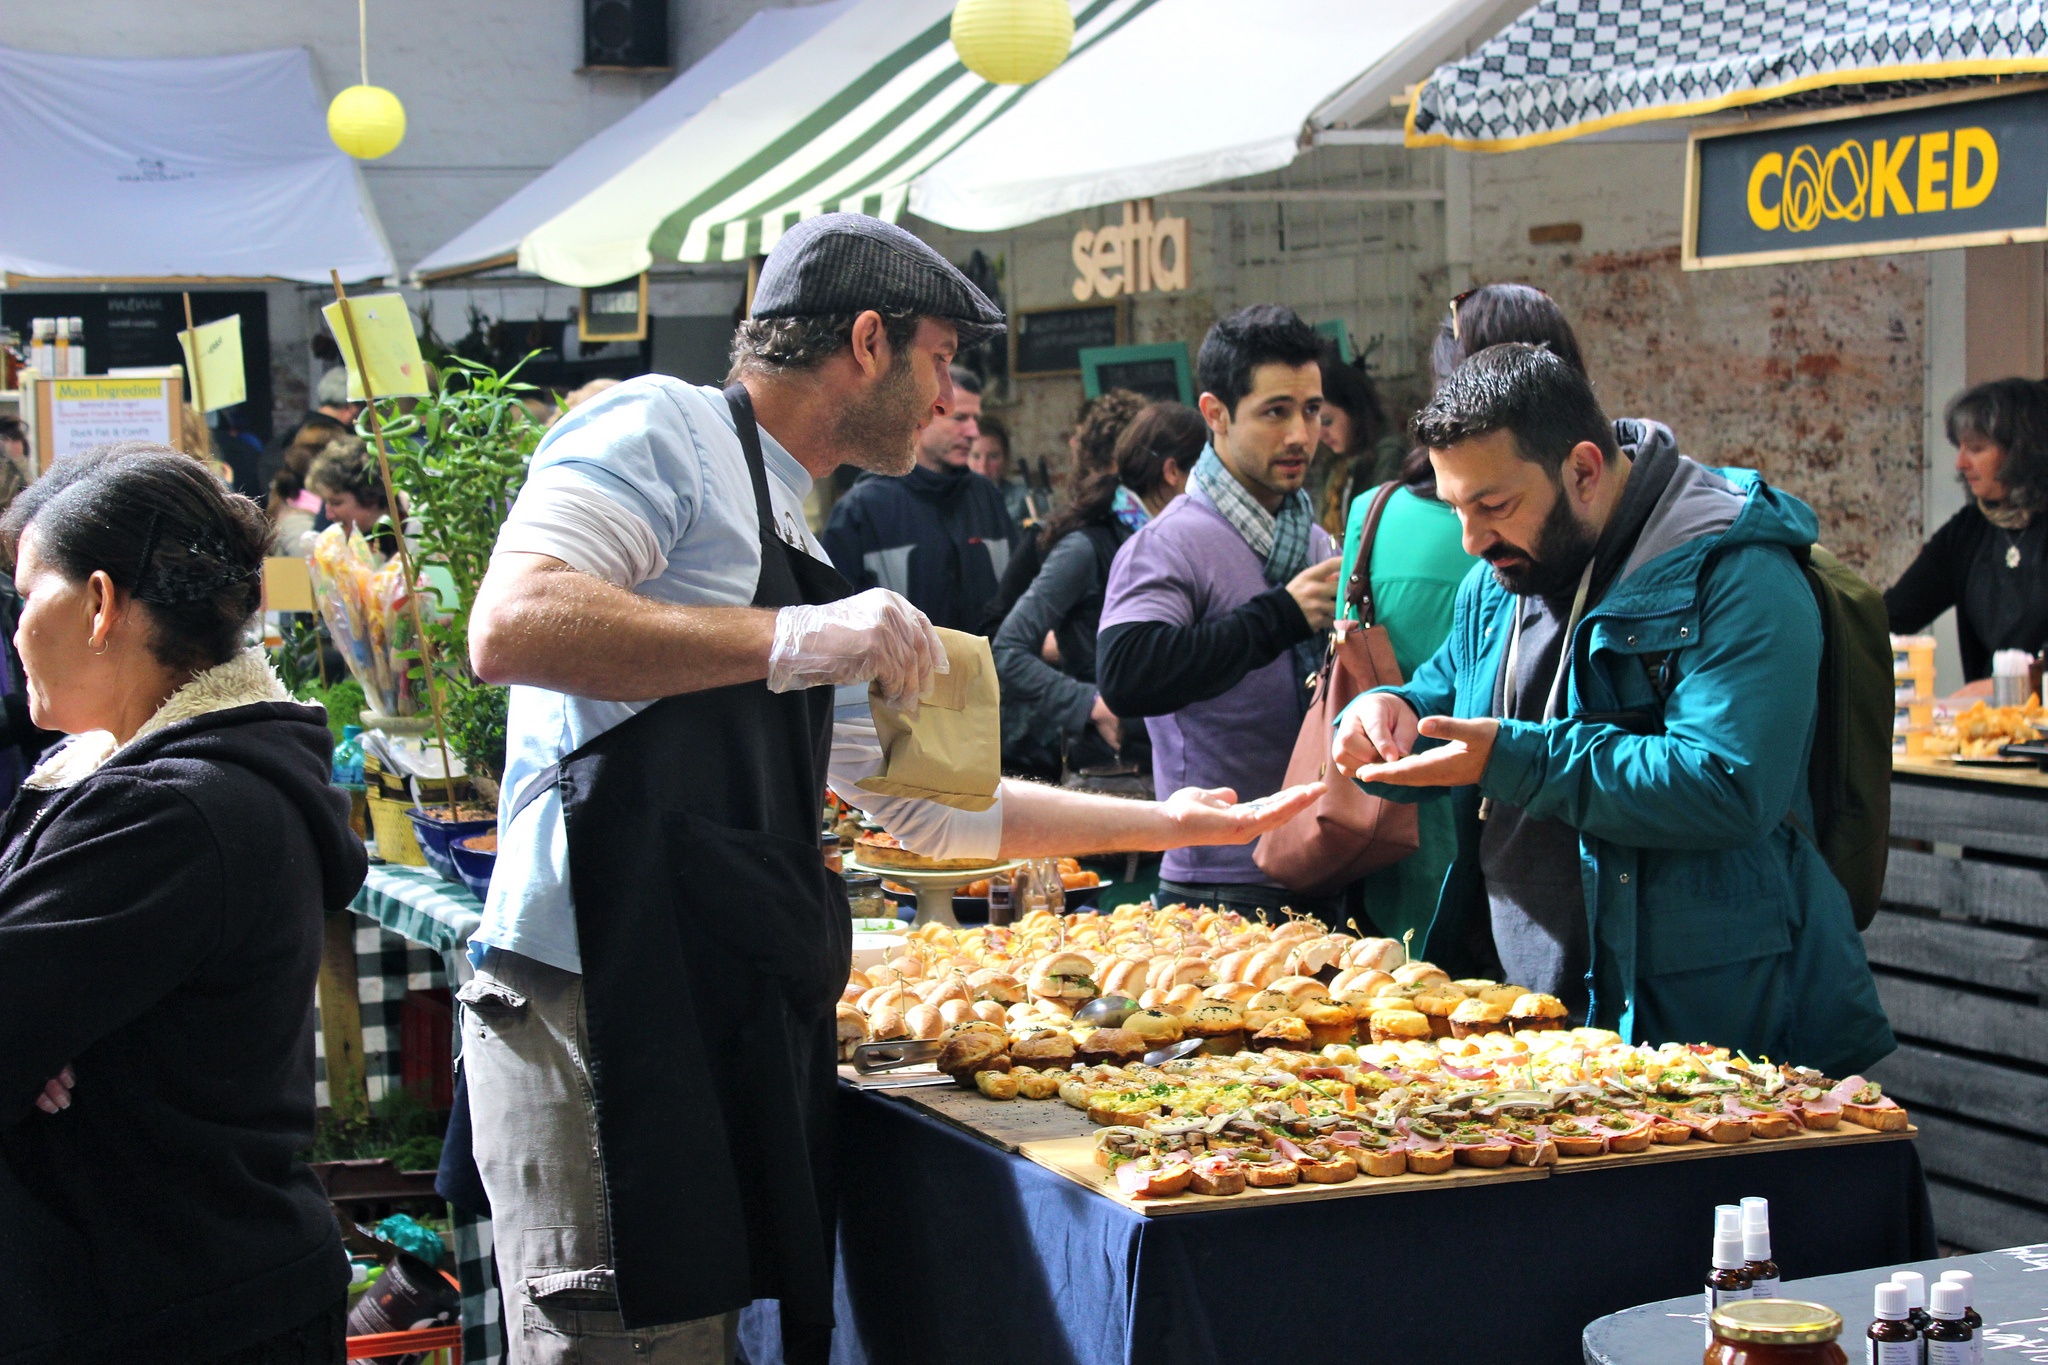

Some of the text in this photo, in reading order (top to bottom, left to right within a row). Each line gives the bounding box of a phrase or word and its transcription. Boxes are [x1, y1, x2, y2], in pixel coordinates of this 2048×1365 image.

[1747, 126, 1999, 233] COOKED
[1072, 198, 1191, 301] setta
[59, 383, 162, 399] Main Ingredient
[70, 428, 93, 438] Duck
[95, 428, 110, 437] Fat
